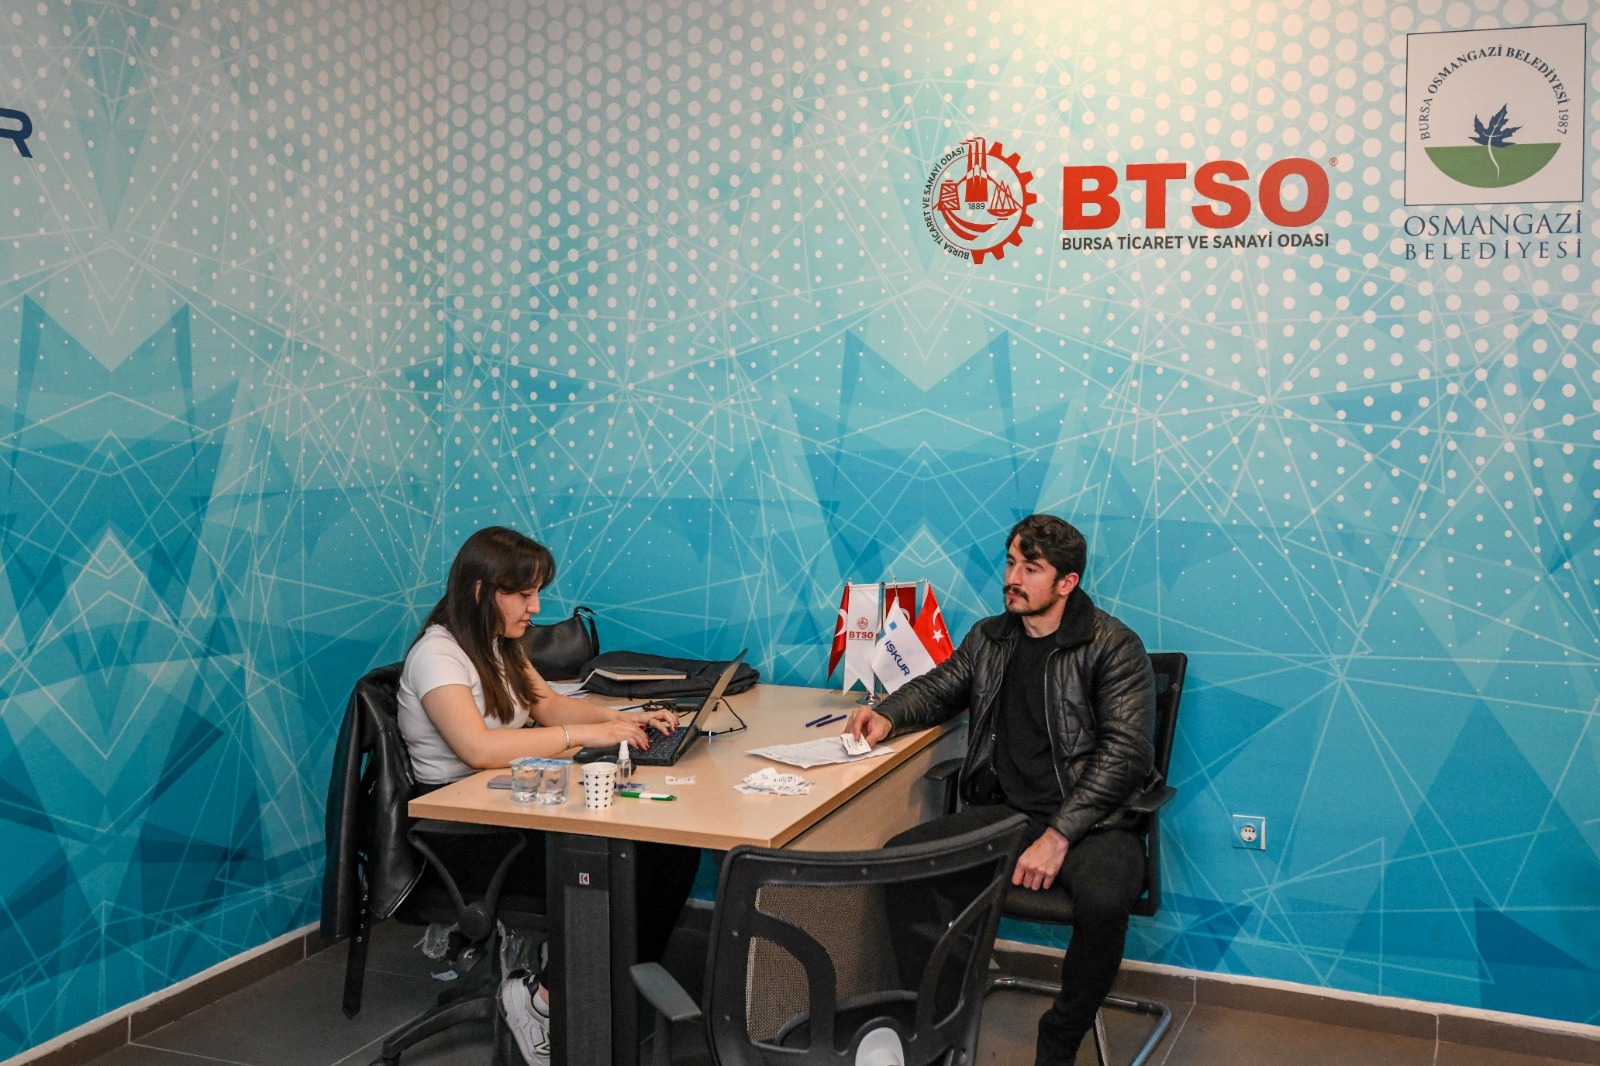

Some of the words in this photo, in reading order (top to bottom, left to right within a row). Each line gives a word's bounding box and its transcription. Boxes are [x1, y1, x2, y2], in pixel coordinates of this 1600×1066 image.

[1419, 97, 1433, 140] BURSA
[1427, 44, 1503, 95] OSMANGAZİ
[1506, 47, 1571, 105] BELEDİYESİ
[1556, 108, 1570, 135] 1987
[940, 146, 965, 166] ODASI
[922, 197, 930, 209] VE
[1063, 157, 1330, 231] BTSO
[968, 202, 985, 210] 1889
[1403, 210, 1583, 237] OSMANGAZİ
[943, 242, 970, 260] BURSA
[1062, 237, 1114, 251] BURSA
[1117, 233, 1184, 250] TİCARET
[1188, 235, 1209, 249] VE
[1212, 231, 1272, 249] SANAYİ
[1277, 232, 1329, 247] ODASI
[1405, 238, 1582, 261] BELEDİYESİ
